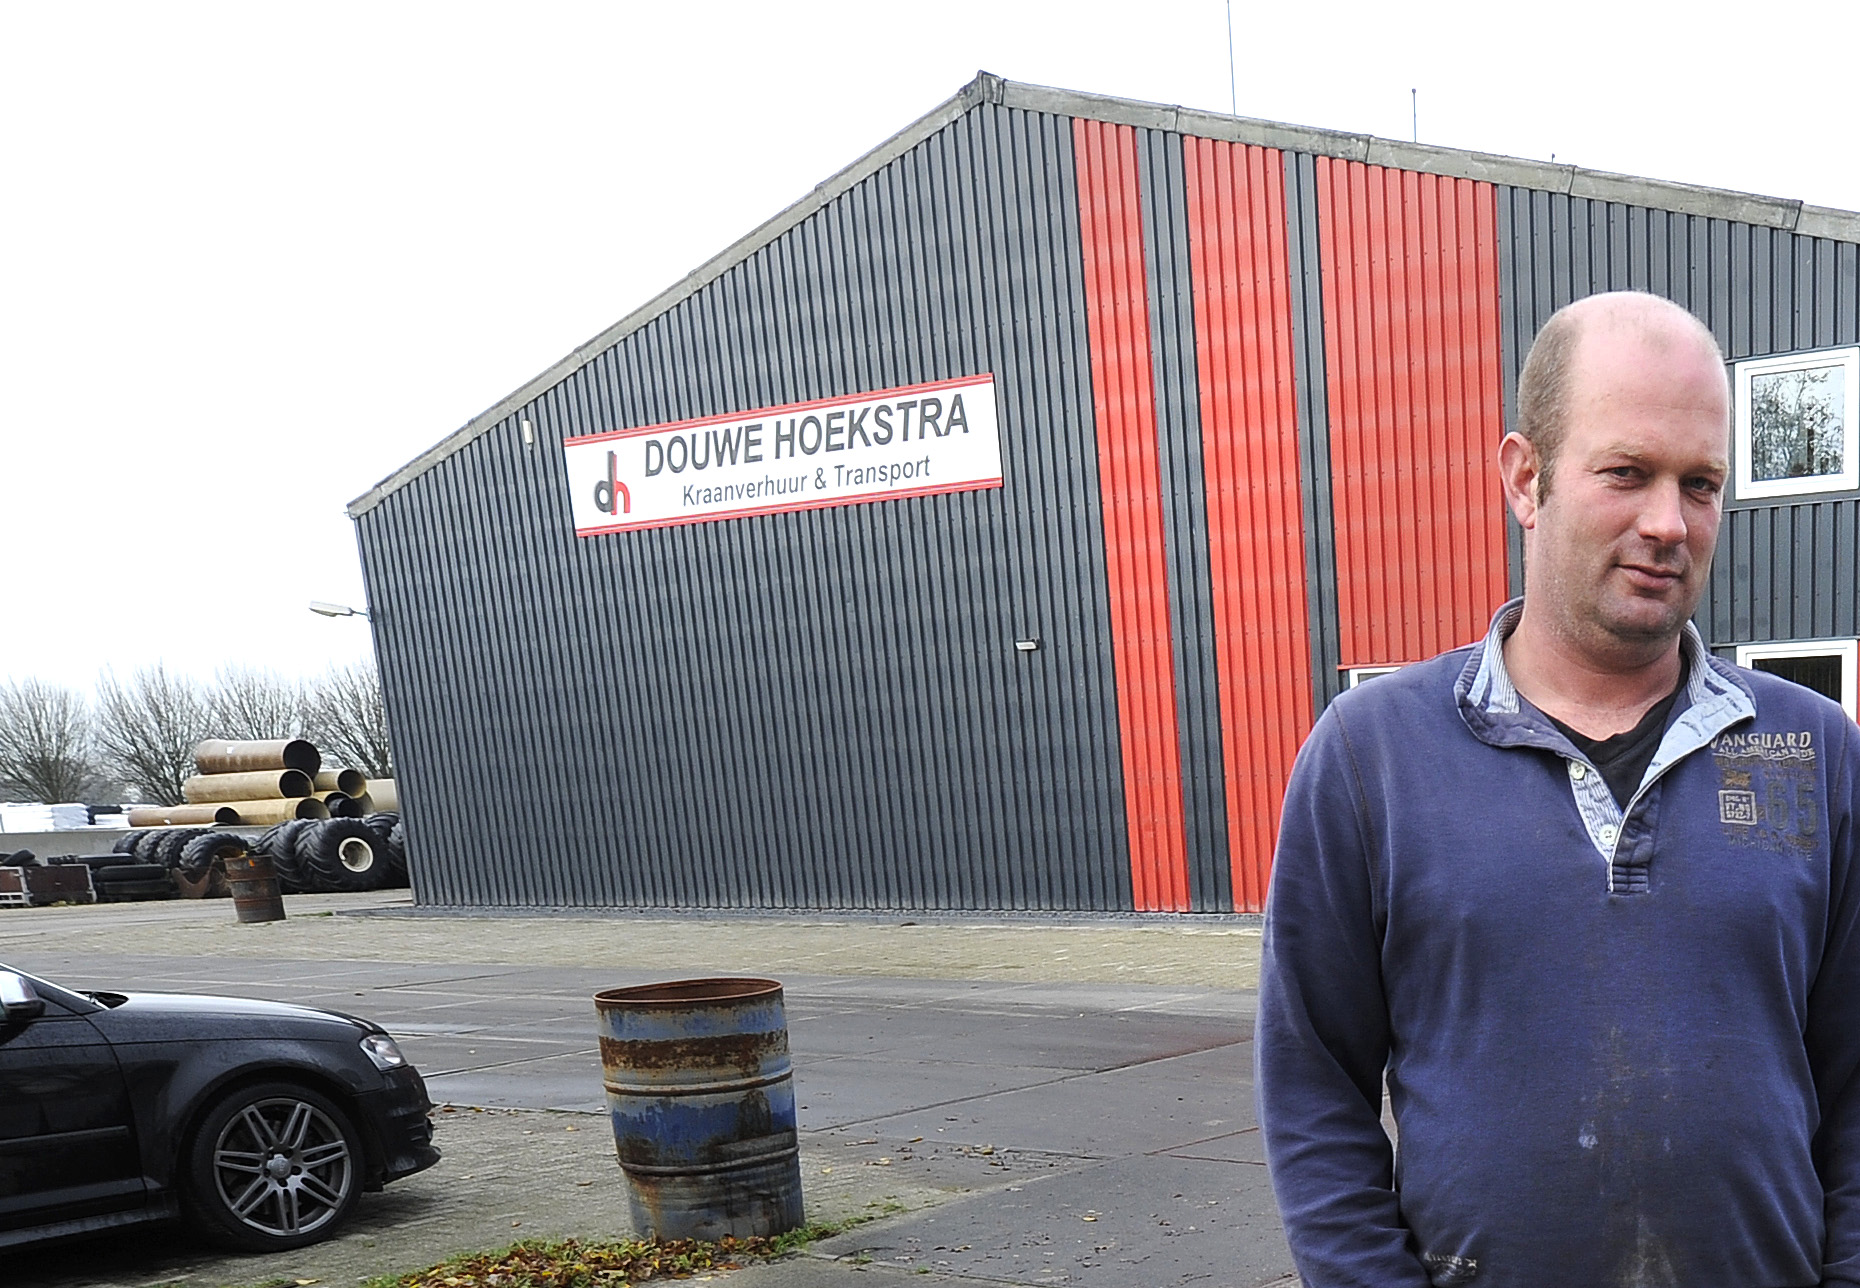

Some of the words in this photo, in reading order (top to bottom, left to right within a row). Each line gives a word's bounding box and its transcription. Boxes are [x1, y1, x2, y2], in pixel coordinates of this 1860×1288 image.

[645, 423, 763, 477] DOUWE
[775, 393, 969, 460] HOEKSTRA
[683, 474, 808, 507] Kraanverhuur
[814, 467, 827, 490] &
[834, 455, 931, 487] Transport
